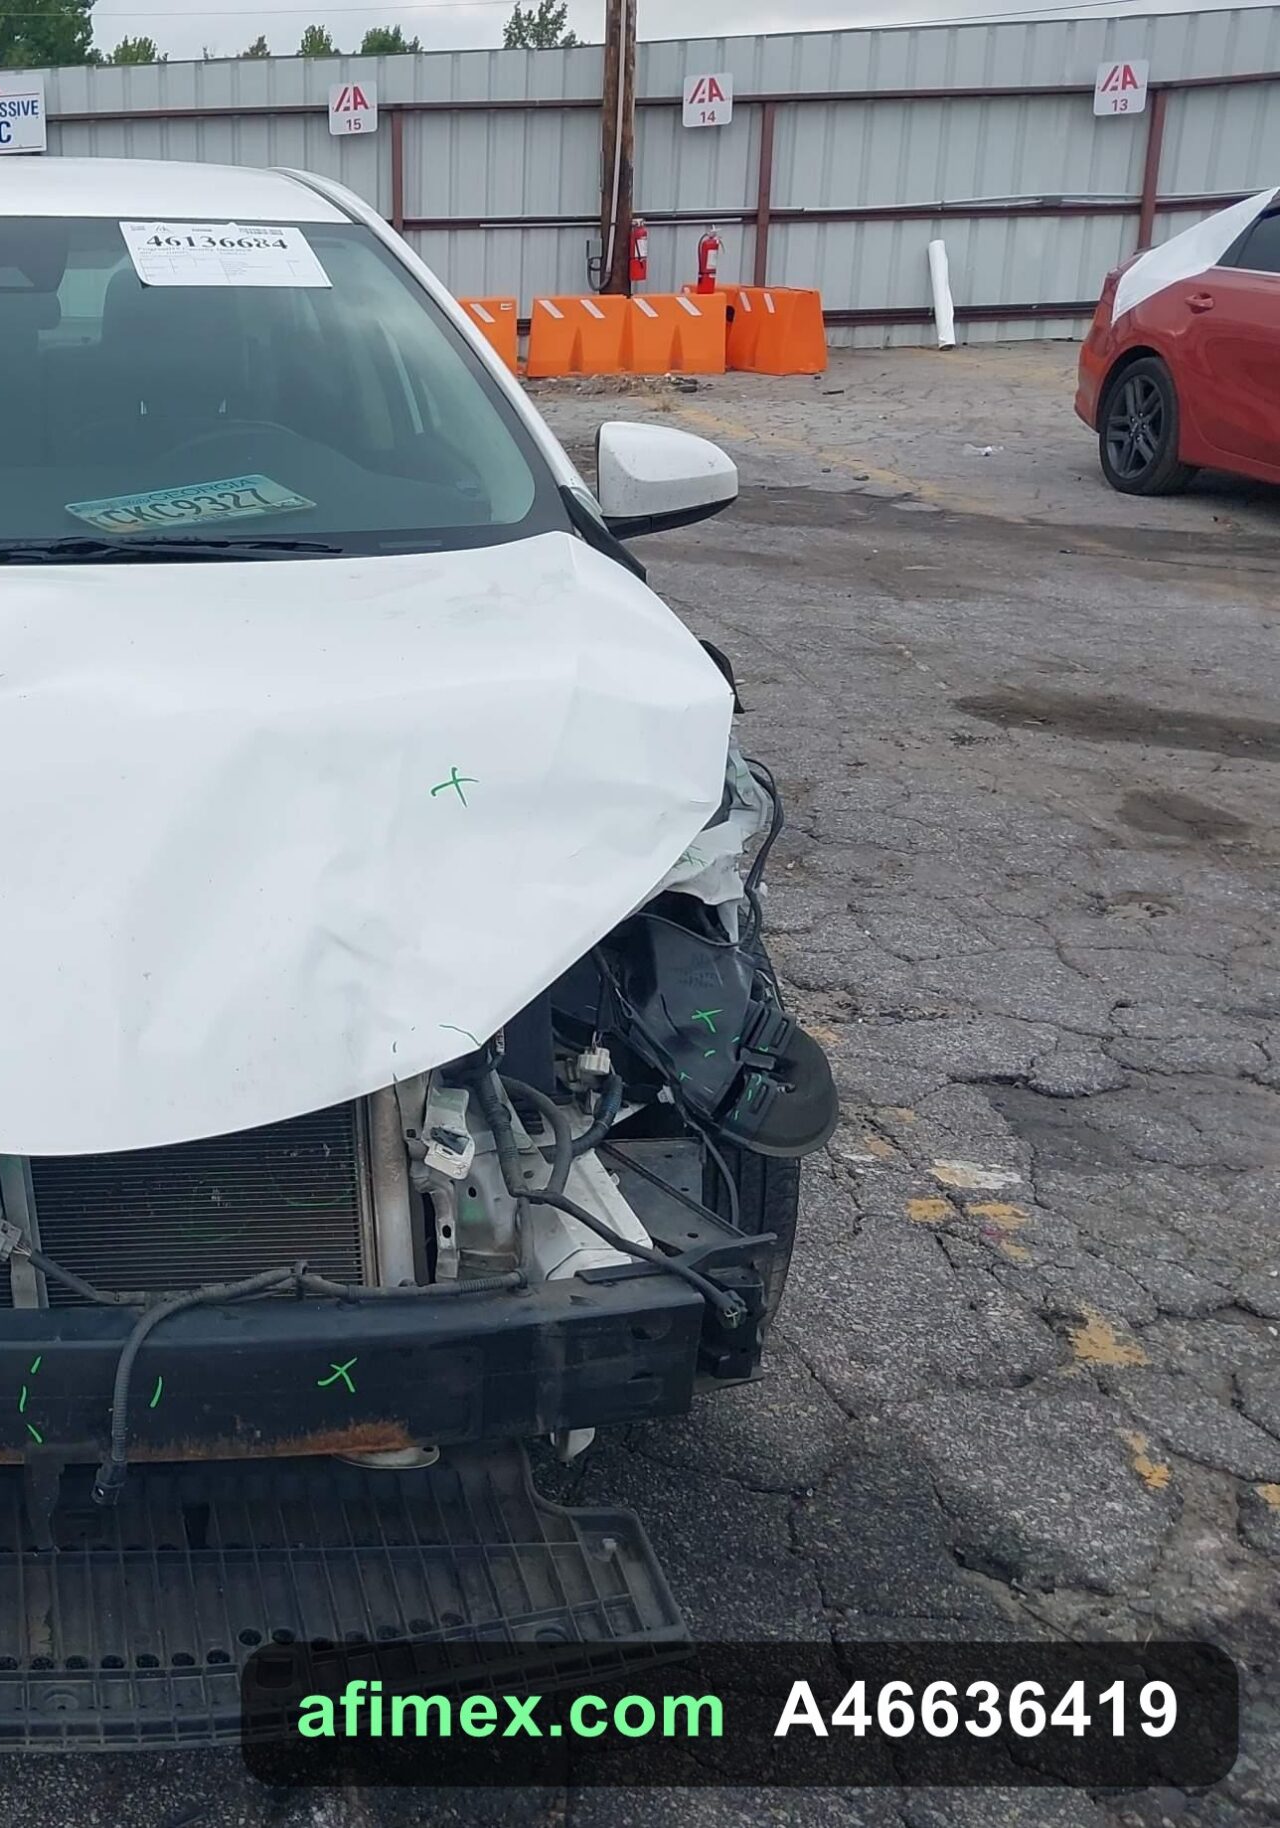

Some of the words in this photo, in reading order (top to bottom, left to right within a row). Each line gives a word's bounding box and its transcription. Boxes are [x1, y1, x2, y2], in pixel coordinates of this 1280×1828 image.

[1112, 98, 1129, 112] 13
[700, 110, 716, 123] 14
[346, 118, 362, 131] 15
[146, 234, 288, 250] 46136684
[148, 480, 257, 501] GEORGIA
[101, 487, 271, 525] CKC9327
